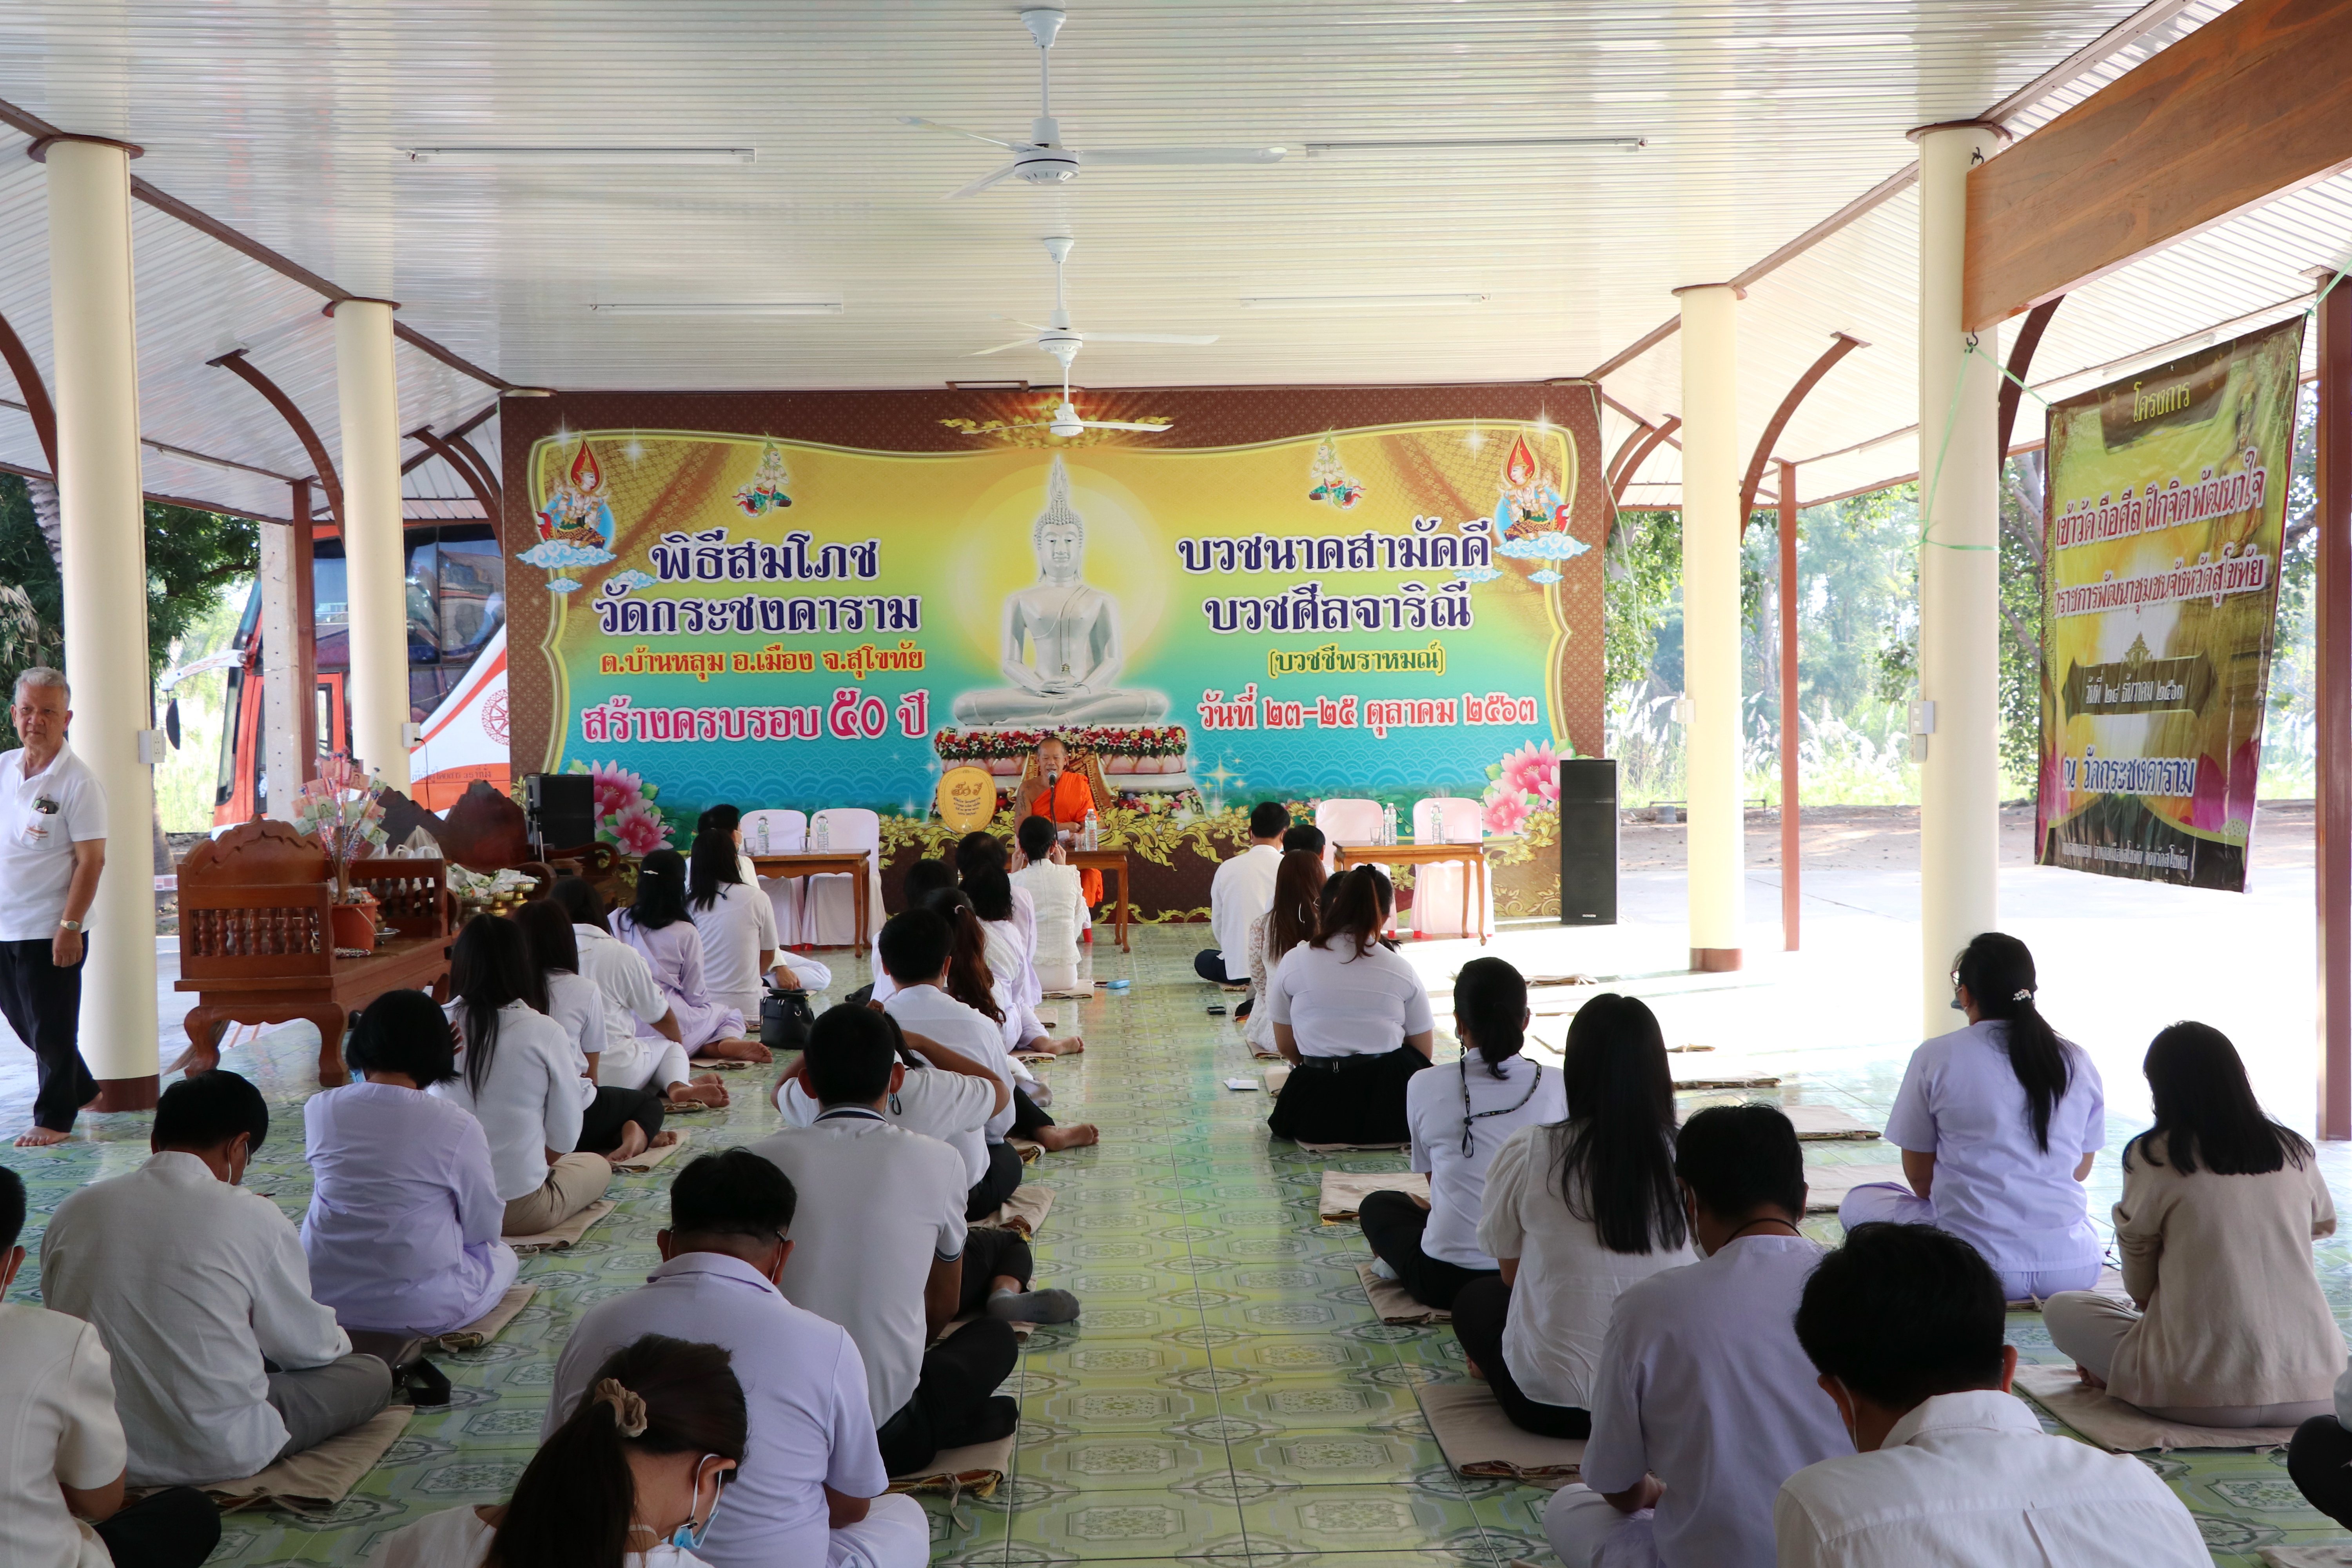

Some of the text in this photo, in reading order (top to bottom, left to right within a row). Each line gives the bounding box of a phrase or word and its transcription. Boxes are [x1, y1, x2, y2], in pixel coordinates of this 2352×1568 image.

[2134, 381, 2190, 422] โครงการ
[2057, 500, 2096, 546] เข้าวัด
[2098, 489, 2141, 538] ถือศีล
[652, 529, 879, 580] พิธีสมโภช
[1179, 518, 1490, 570] บวชนาคสามัคคี
[595, 581, 918, 632] วัดกระชงคาราม
[1205, 582, 1471, 630] บวชศีลจาริณี
[601, 642, 924, 680] ต.บ้านหลุม อ.เมือง จ.สุโขทัย
[1270, 642, 1443, 676] (บวชชีพราหมณ์)
[1200, 686, 1255, 728] วันที่
[1367, 701, 1454, 736] ตุลาคม
[1464, 695, 1536, 724] ๒๕๖๓
[2086, 669, 2103, 704] วันที่
[2156, 679, 2183, 701] ๒๕๖๓
[584, 689, 927, 740] สร้างครบรอบ ๕๐ ปี
[2065, 746, 2195, 793] ณ วัดกระชงคาราม
